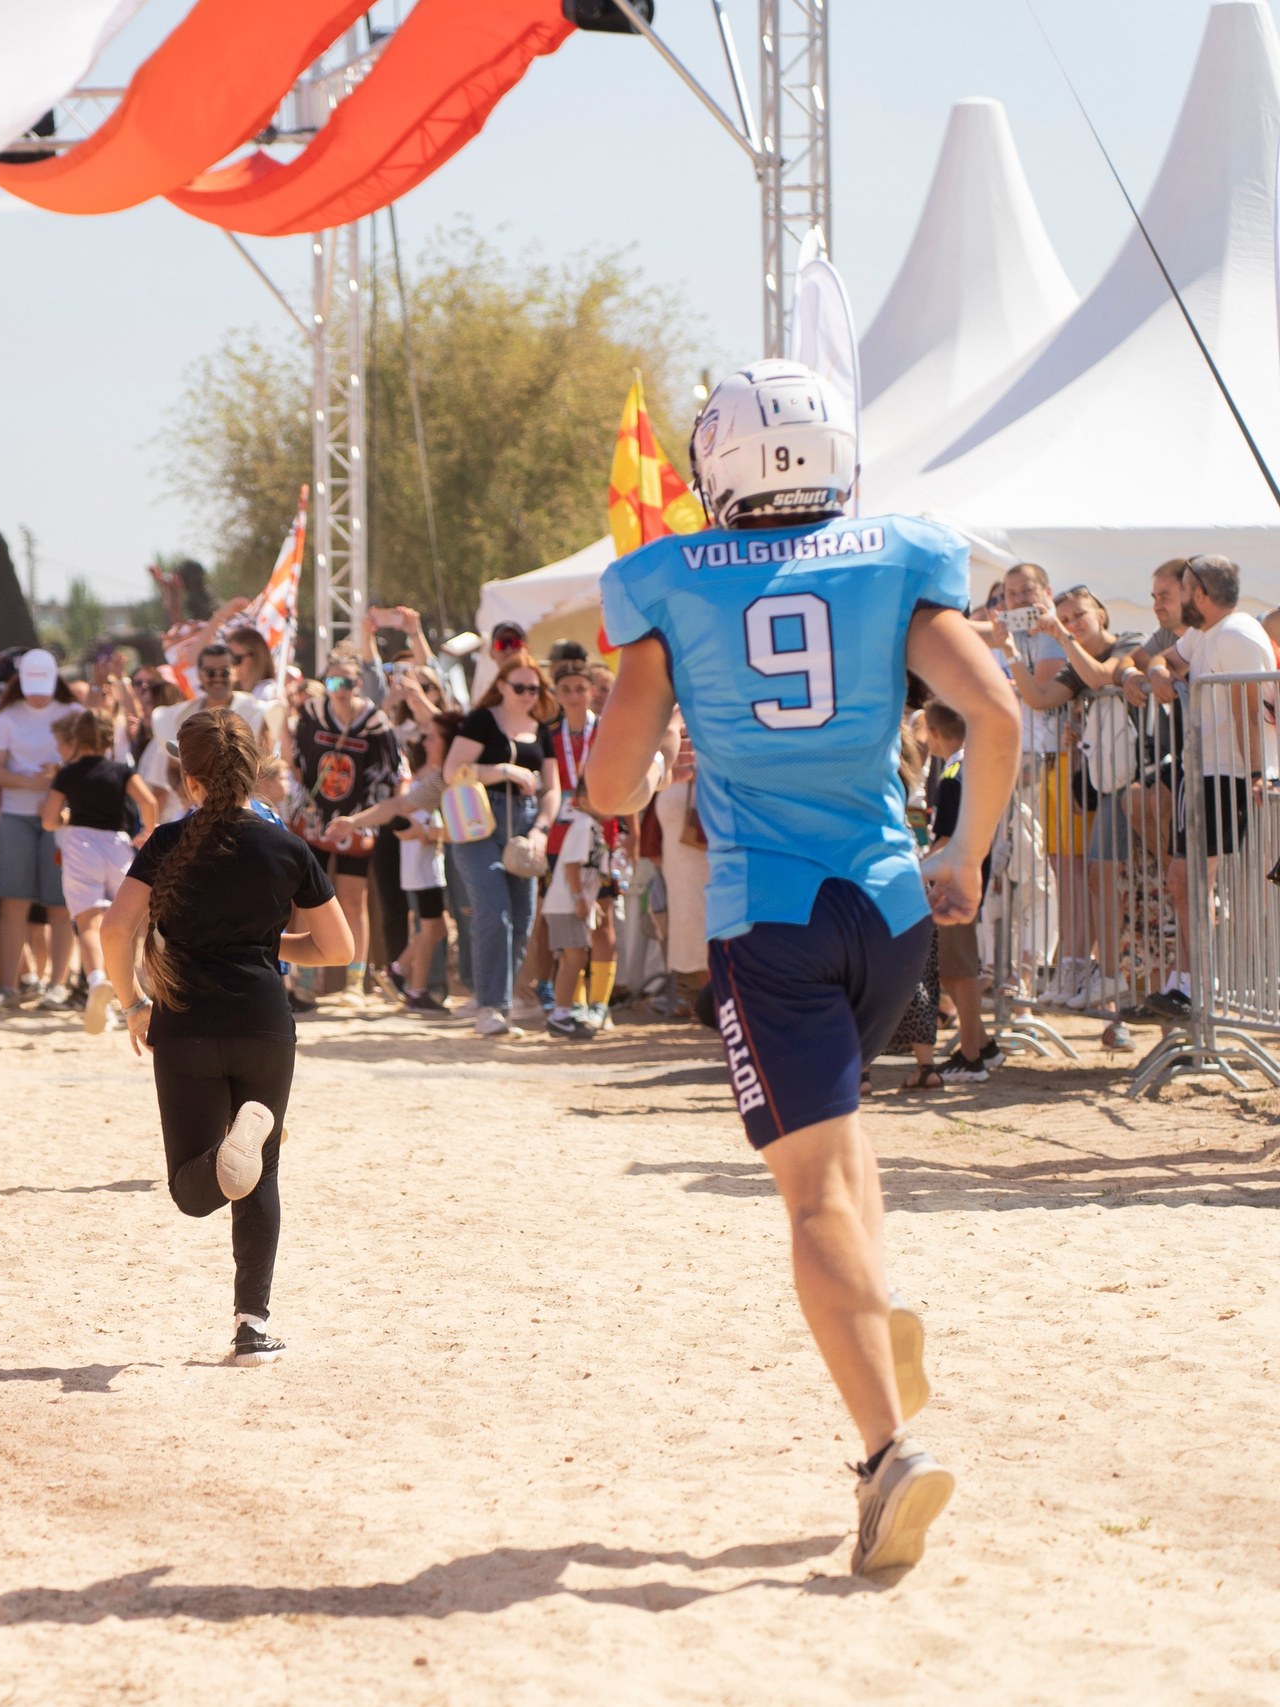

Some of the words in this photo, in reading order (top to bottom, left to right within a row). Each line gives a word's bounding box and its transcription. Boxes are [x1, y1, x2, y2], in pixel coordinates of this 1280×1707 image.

[775, 446, 790, 472] 9
[772, 488, 829, 506] schutt
[681, 528, 885, 569] VOLGOGRAD
[744, 593, 837, 730] 9
